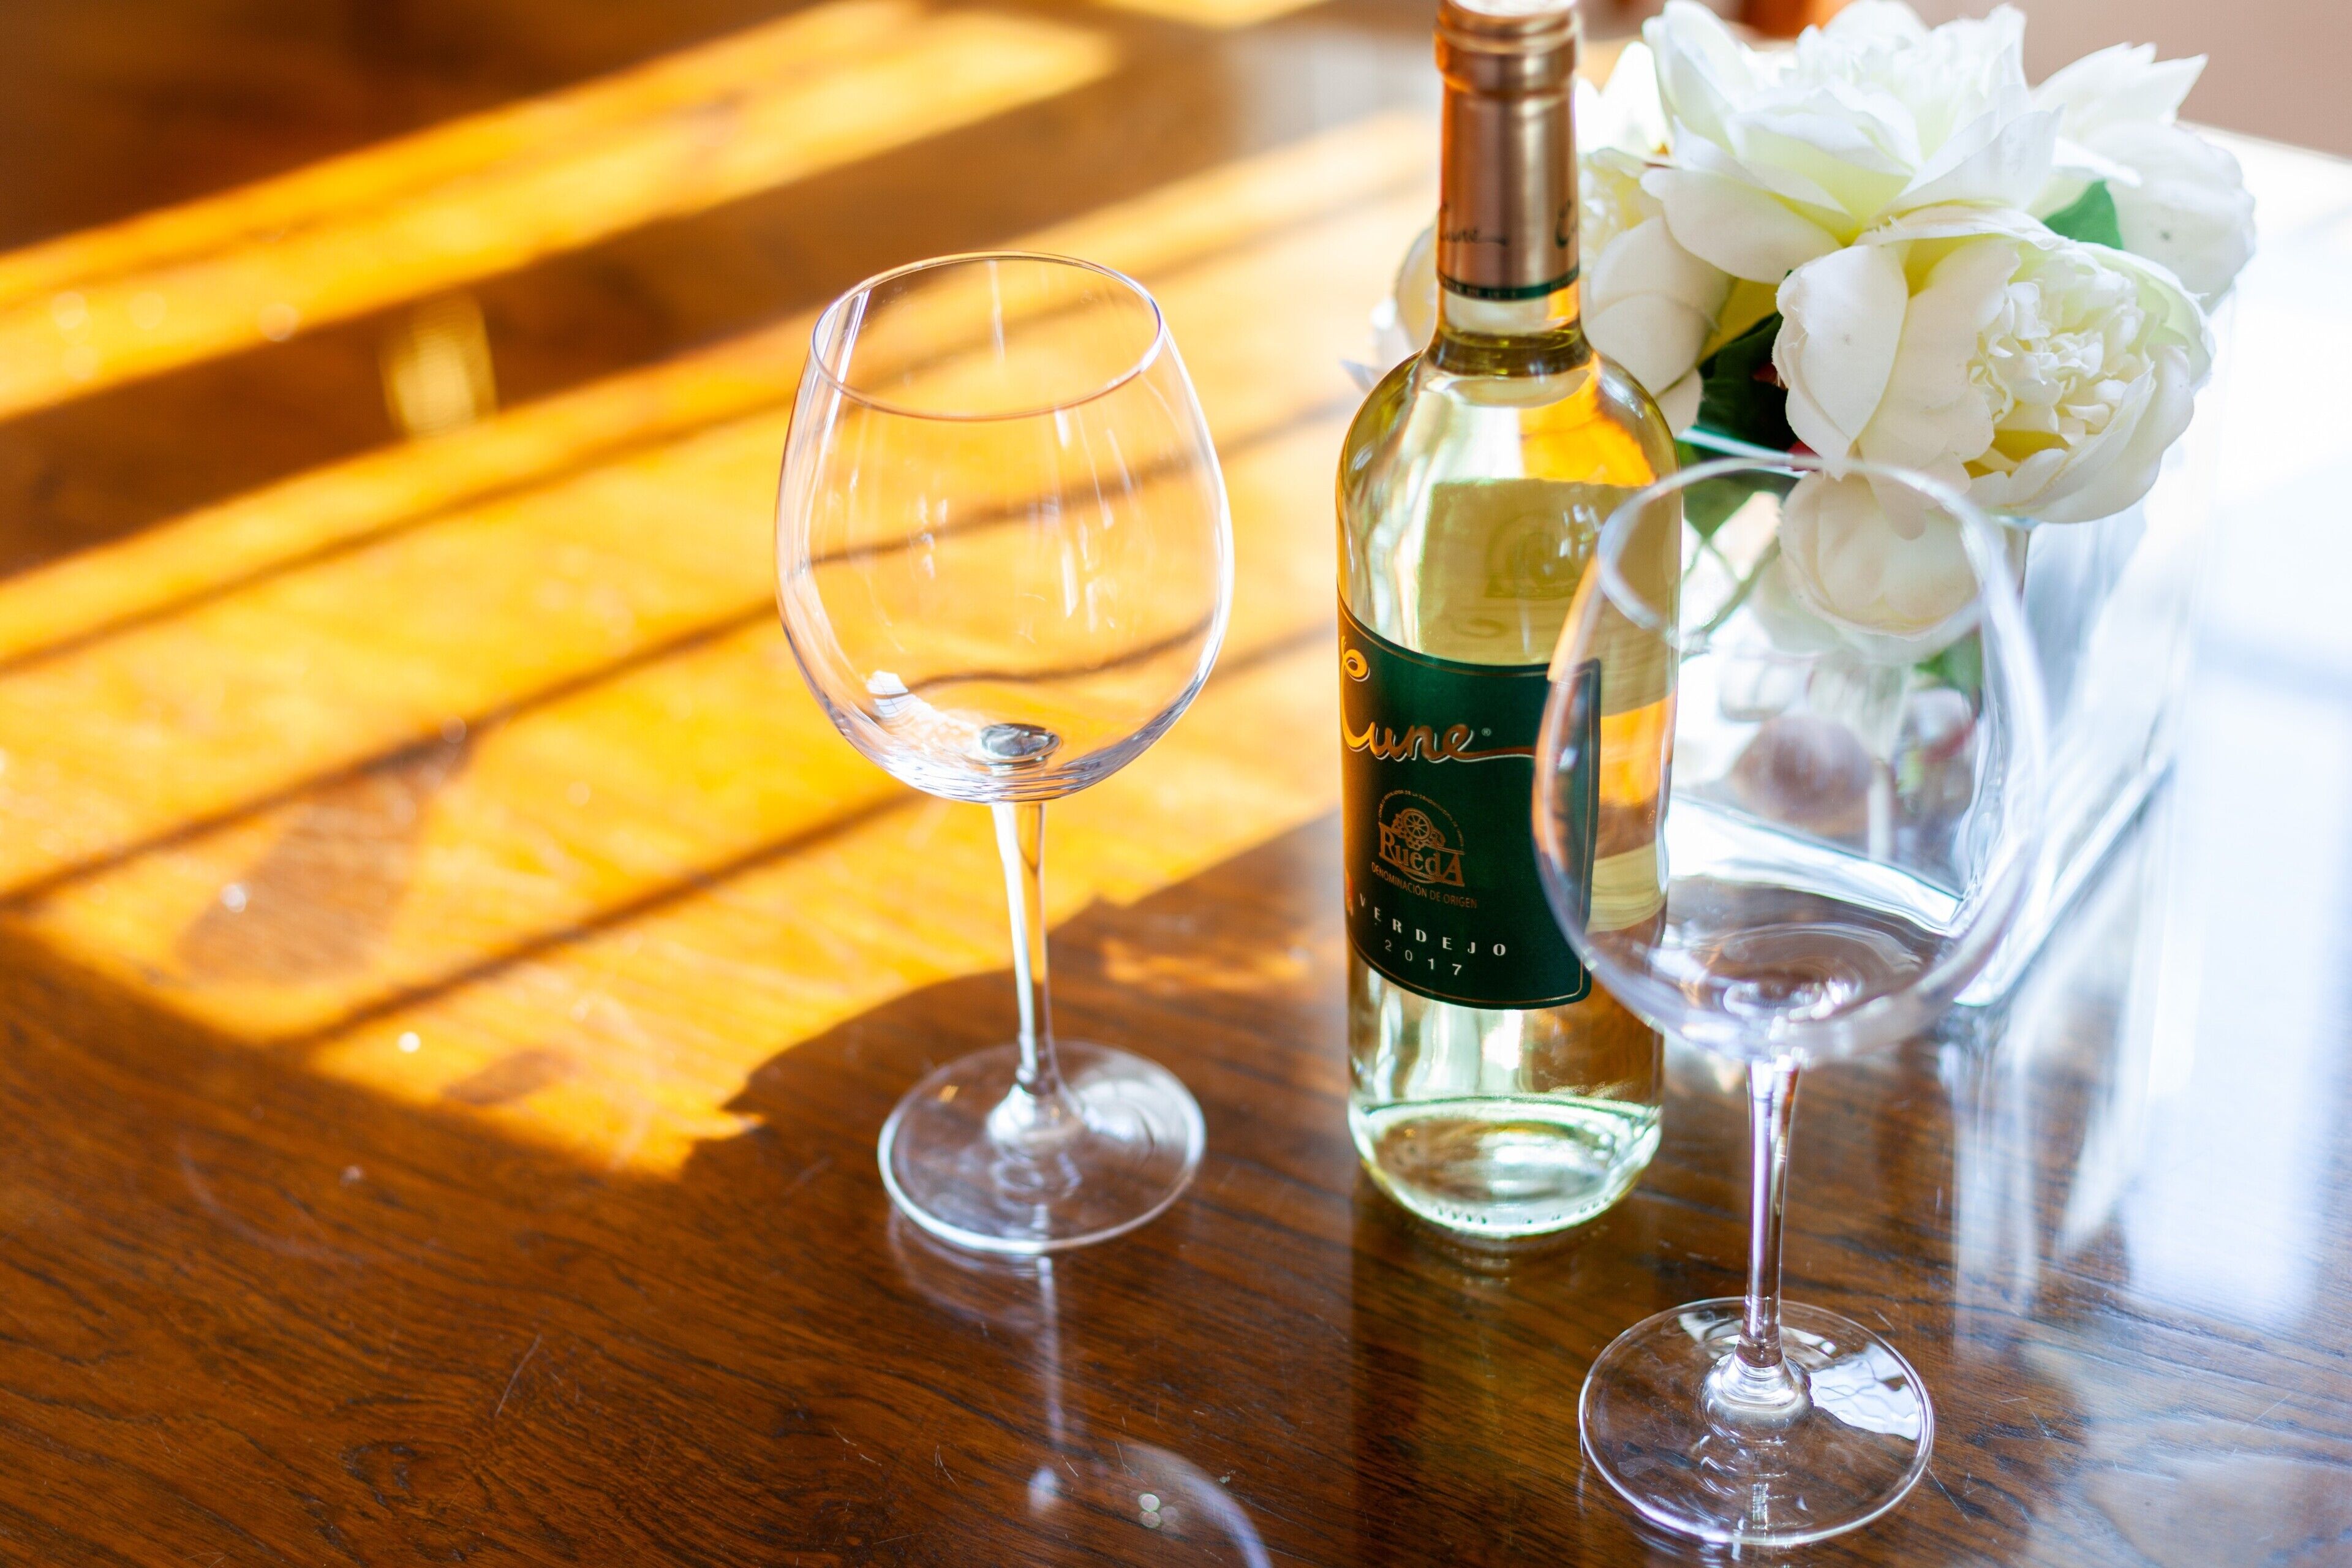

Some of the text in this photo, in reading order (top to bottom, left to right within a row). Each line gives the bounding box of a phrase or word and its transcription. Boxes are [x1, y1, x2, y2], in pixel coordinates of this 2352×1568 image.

[1341, 636, 1534, 763] Cune
[1371, 862, 1477, 908] DENOMINACIÓN DE ORIGEN
[1359, 892, 1506, 956] VERDEJO
[1384, 939, 1462, 976] 2017
